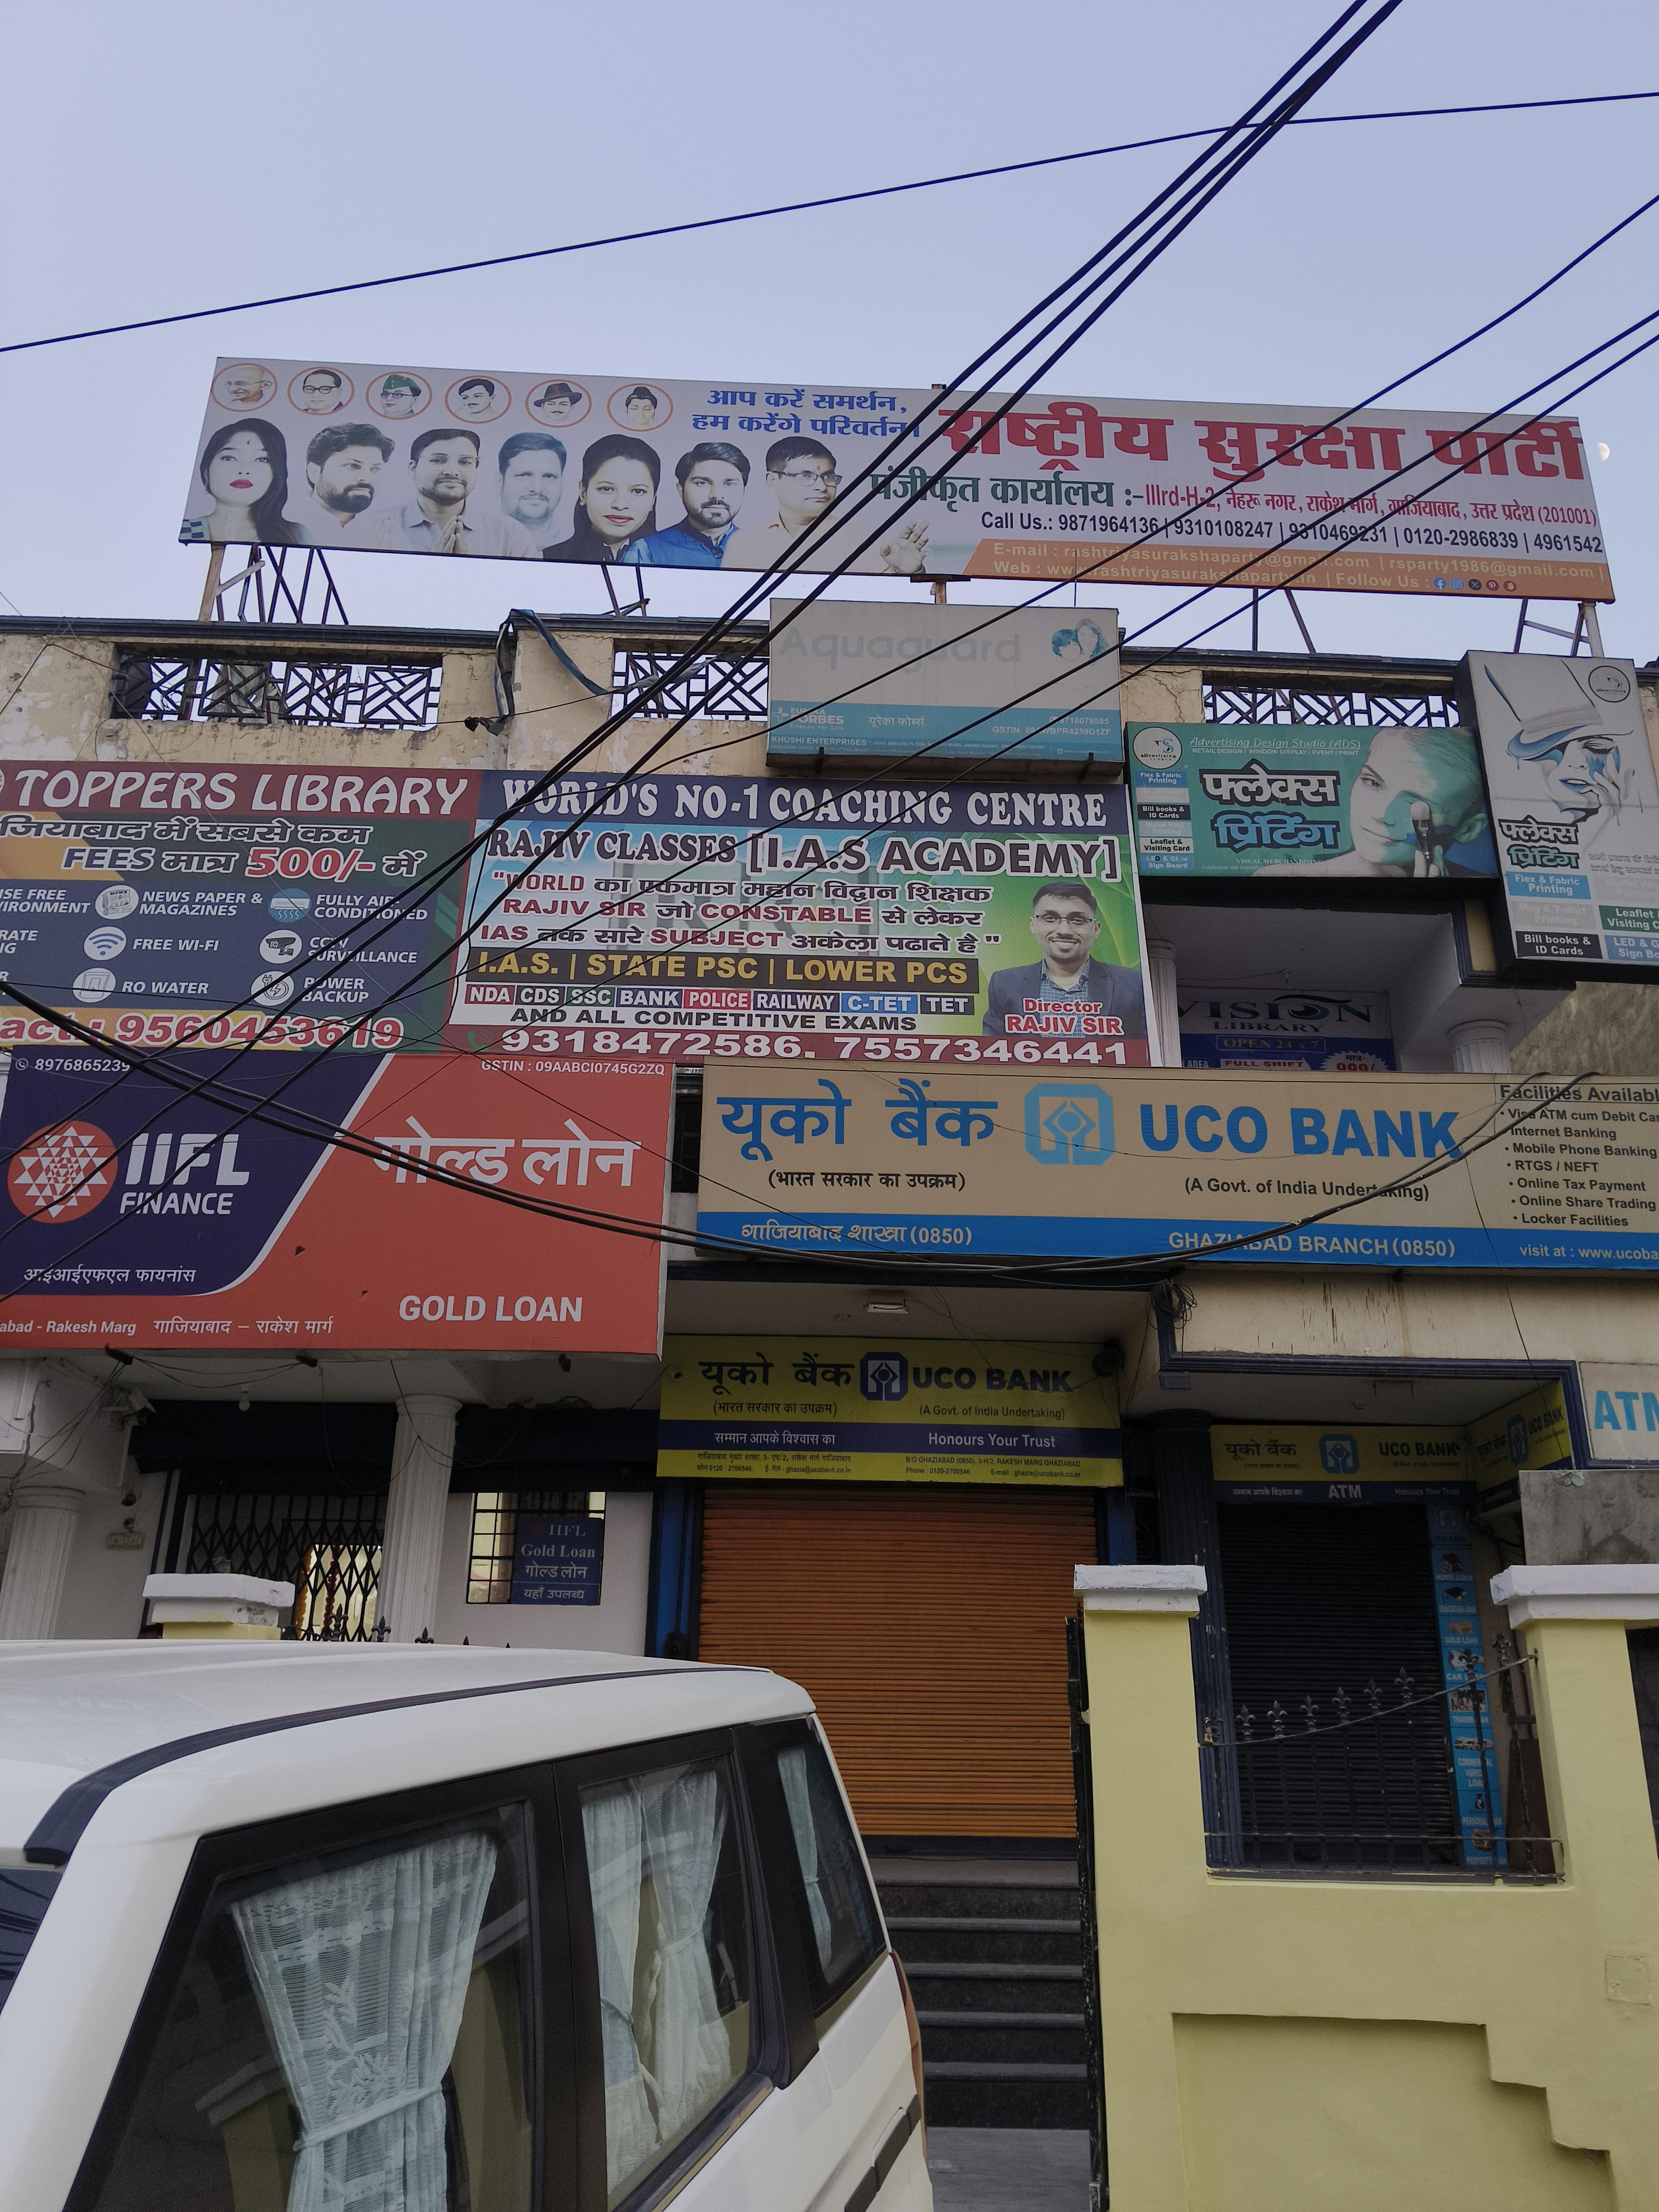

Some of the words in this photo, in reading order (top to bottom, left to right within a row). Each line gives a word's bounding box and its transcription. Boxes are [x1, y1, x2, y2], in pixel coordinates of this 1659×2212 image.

[707, 389, 757, 406] आप
[765, 388, 805, 408] करें
[812, 391, 907, 413] समर्थन,
[692, 414, 730, 430] हम
[738, 413, 802, 433] करेंगे
[938, 401, 1173, 471] राष्ट्रीय
[1194, 419, 1406, 482] सुरक्षा
[1425, 421, 1585, 481] पार्टी
[990, 471, 1114, 506] कार्यालय
[1225, 488, 1260, 510] नेहरू
[1264, 494, 1302, 513] नगर,
[1305, 491, 1344, 512] राकेश
[1469, 503, 1498, 519] उत्तर
[1502, 499, 1535, 522] प्रदेश
[1538, 506, 1597, 527] (201001)
[981, 511, 1013, 529] Call
[1058, 514, 1158, 534] 9871964136
[1174, 518, 1273, 538] 9310108247
[1289, 522, 1387, 543] 9310469231
[1404, 527, 1518, 548] 0120-2986839
[1534, 534, 1603, 553] 4961542
[994, 542, 1047, 557] E-mail
[1389, 559, 1594, 578] rsparty1986@gmail.com
[994, 561, 1030, 575] Web
[1336, 575, 1392, 587] Follow
[779, 626, 1021, 673] Aquaguard
[806, 737, 866, 746] ENTERPRISES
[1190, 737, 1250, 747] Advertising
[1253, 738, 1288, 748] Design
[1292, 739, 1325, 747] Studio
[1330, 739, 1360, 749] (ADS)
[14, 769, 238, 810] TOPPERS
[251, 774, 468, 815] LIBRARY
[1200, 761, 1338, 805] फ्लेक्स
[504, 780, 658, 816] WORLD'S
[675, 784, 759, 819] NO-1
[769, 787, 951, 825] COACHING
[967, 792, 1106, 827] CENTRE
[197, 818, 294, 842] सबसे
[298, 825, 373, 844] कम
[1499, 816, 1577, 843] फ्लेक्स
[489, 829, 590, 859] RAJIV
[596, 832, 736, 863] CLASSES
[881, 839, 1118, 879] ACADEMY]
[62, 848, 155, 870] FEES
[162, 852, 239, 872] मात्र
[245, 847, 376, 882] 500/-
[1515, 874, 1536, 883] Flex
[1550, 876, 1580, 886] Fabric
[142, 891, 191, 902] NEWS
[195, 892, 246, 903] PAPER
[594, 879, 631, 893] का
[639, 880, 735, 897] एकमात्र
[742, 882, 817, 899] महान
[908, 882, 993, 903] शिक्षक
[1528, 883, 1573, 896] Printing
[316, 894, 364, 906] FULLY
[140, 904, 238, 916] MAGAZINES
[701, 904, 871, 923] CONSTABLE
[914, 908, 982, 927] लेकर
[1615, 908, 1654, 918] Leaflet
[132, 939, 173, 950] FREE
[178, 940, 219, 951] WI-FI
[481, 926, 528, 940] IAS
[594, 926, 645, 944] सारे
[650, 930, 784, 947] SUBJECT
[791, 930, 879, 950] अकेला
[1551, 946, 1584, 955] Cards
[1618, 948, 1643, 960] Sign
[587, 955, 685, 977] STATE
[697, 957, 757, 978] PSC
[786, 959, 895, 982] LOWER
[907, 962, 967, 984] PCS
[122, 981, 145, 993] RO
[151, 982, 209, 994] WATER
[469, 987, 511, 1003] NDA
[520, 988, 560, 1003] CDS
[620, 991, 679, 1006] BANK
[689, 992, 748, 1008] POLICE
[757, 993, 835, 1010] RAILWAY
[847, 995, 912, 1012] C-TET
[926, 998, 968, 1013] TET
[1023, 999, 1101, 1013] Director
[117, 1013, 403, 1047] 9560453619
[635, 1011, 816, 1028] COMPETITIVE
[825, 1016, 916, 1031] EXAMS
[1007, 1016, 1075, 1033] RAJIV
[1083, 1018, 1120, 1034] SIR
[1214, 1022, 1324, 1032] LIBRARY
[501, 1030, 816, 1059] 9318472586.
[834, 1037, 1126, 1065] 7557346441
[1223, 1038, 1270, 1048] OPEN
[481, 1060, 523, 1071] GSTIN
[536, 1061, 665, 1075] 09AABCI0745G2ZQ
[717, 1079, 852, 1162] यूको
[885, 1078, 998, 1147] बैंक
[1540, 1109, 1567, 1120] ATM
[1602, 1111, 1636, 1122] Debit
[1140, 1104, 1268, 1154] UCO
[1290, 1108, 1462, 1158] BANK
[1564, 1127, 1616, 1141] Banking
[373, 1116, 515, 1185] गोल्ड
[521, 1118, 642, 1186] लोन
[1513, 1142, 1555, 1154] Mobile
[1560, 1144, 1600, 1155] Phone
[125, 1133, 250, 1186] IIFL
[1515, 1160, 1552, 1171] RTGS
[821, 1172, 874, 1188] सरकार
[1207, 1179, 1250, 1194] Govt.
[1276, 1180, 1317, 1195] India
[1589, 1179, 1646, 1193] Payment
[120, 1192, 233, 1215] FINANCE
[1566, 1196, 1603, 1208] Share
[1607, 1198, 1656, 1212] Trading
[1522, 1213, 1566, 1225] Locker
[848, 1224, 907, 1243] शाखा
[911, 1226, 973, 1246] (0850)
[1299, 1237, 1389, 1257] BRANCH
[1393, 1237, 1455, 1258] (0850)
[135, 1265, 196, 1283] फायनांस
[399, 1295, 486, 1321] GOLD
[496, 1297, 583, 1322] LOAN
[47, 1321, 96, 1334] Rakesh
[101, 1321, 136, 1336] Marg
[154, 1316, 232, 1334] गाजियाबाद
[256, 1316, 299, 1334] राकेश
[305, 1316, 333, 1334] मार्ग
[698, 1352, 774, 1395] यूको
[792, 1352, 854, 1386] बैंक
[913, 1367, 976, 1389] UCO
[986, 1369, 1072, 1392] BANK
[1002, 1407, 1065, 1420] Undertaking)
[714, 1432, 746, 1444] सम्मान
[782, 1430, 818, 1445] विश्वास
[929, 1432, 984, 1446] Honours
[988, 1433, 1018, 1446] Your
[1022, 1435, 1056, 1448] Trust
[1329, 1485, 1362, 1499] ATM
[521, 1544, 554, 1557] Gold
[560, 1545, 595, 1558] Loan
[561, 1561, 588, 1579] लोन
